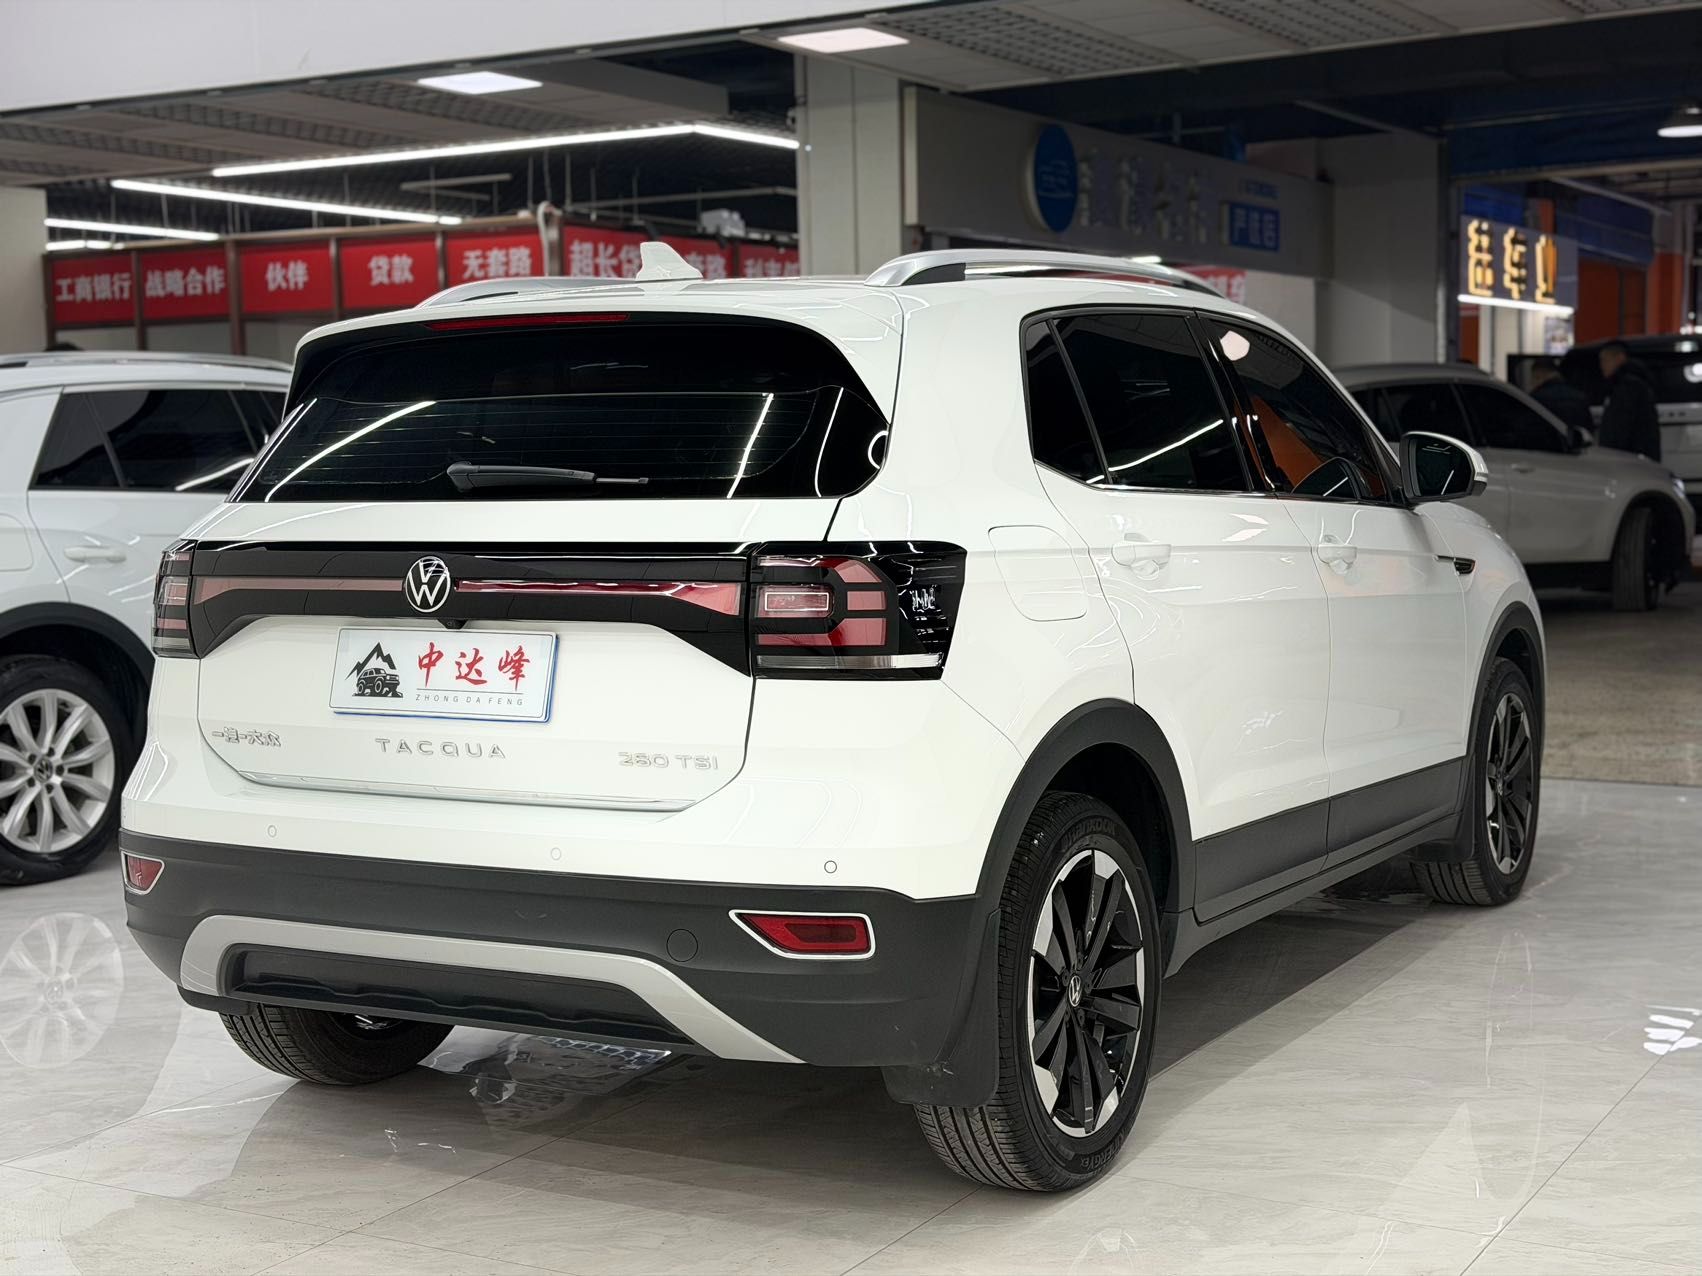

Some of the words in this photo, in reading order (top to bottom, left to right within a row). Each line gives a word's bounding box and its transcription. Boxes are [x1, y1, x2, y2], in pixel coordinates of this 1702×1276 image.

[56, 271, 133, 303] 工商银行
[145, 265, 226, 299] 战略合作
[265, 260, 309, 291] 伙伴
[368, 253, 413, 287] 贷款
[461, 246, 532, 279] 无套路
[417, 641, 531, 692] 中达峰
[415, 692, 459, 704] ZHONG
[465, 695, 481, 704] DA
[488, 696, 523, 706] FENG
[375, 737, 506, 759] TACQUA
[675, 753, 720, 770] TSI
